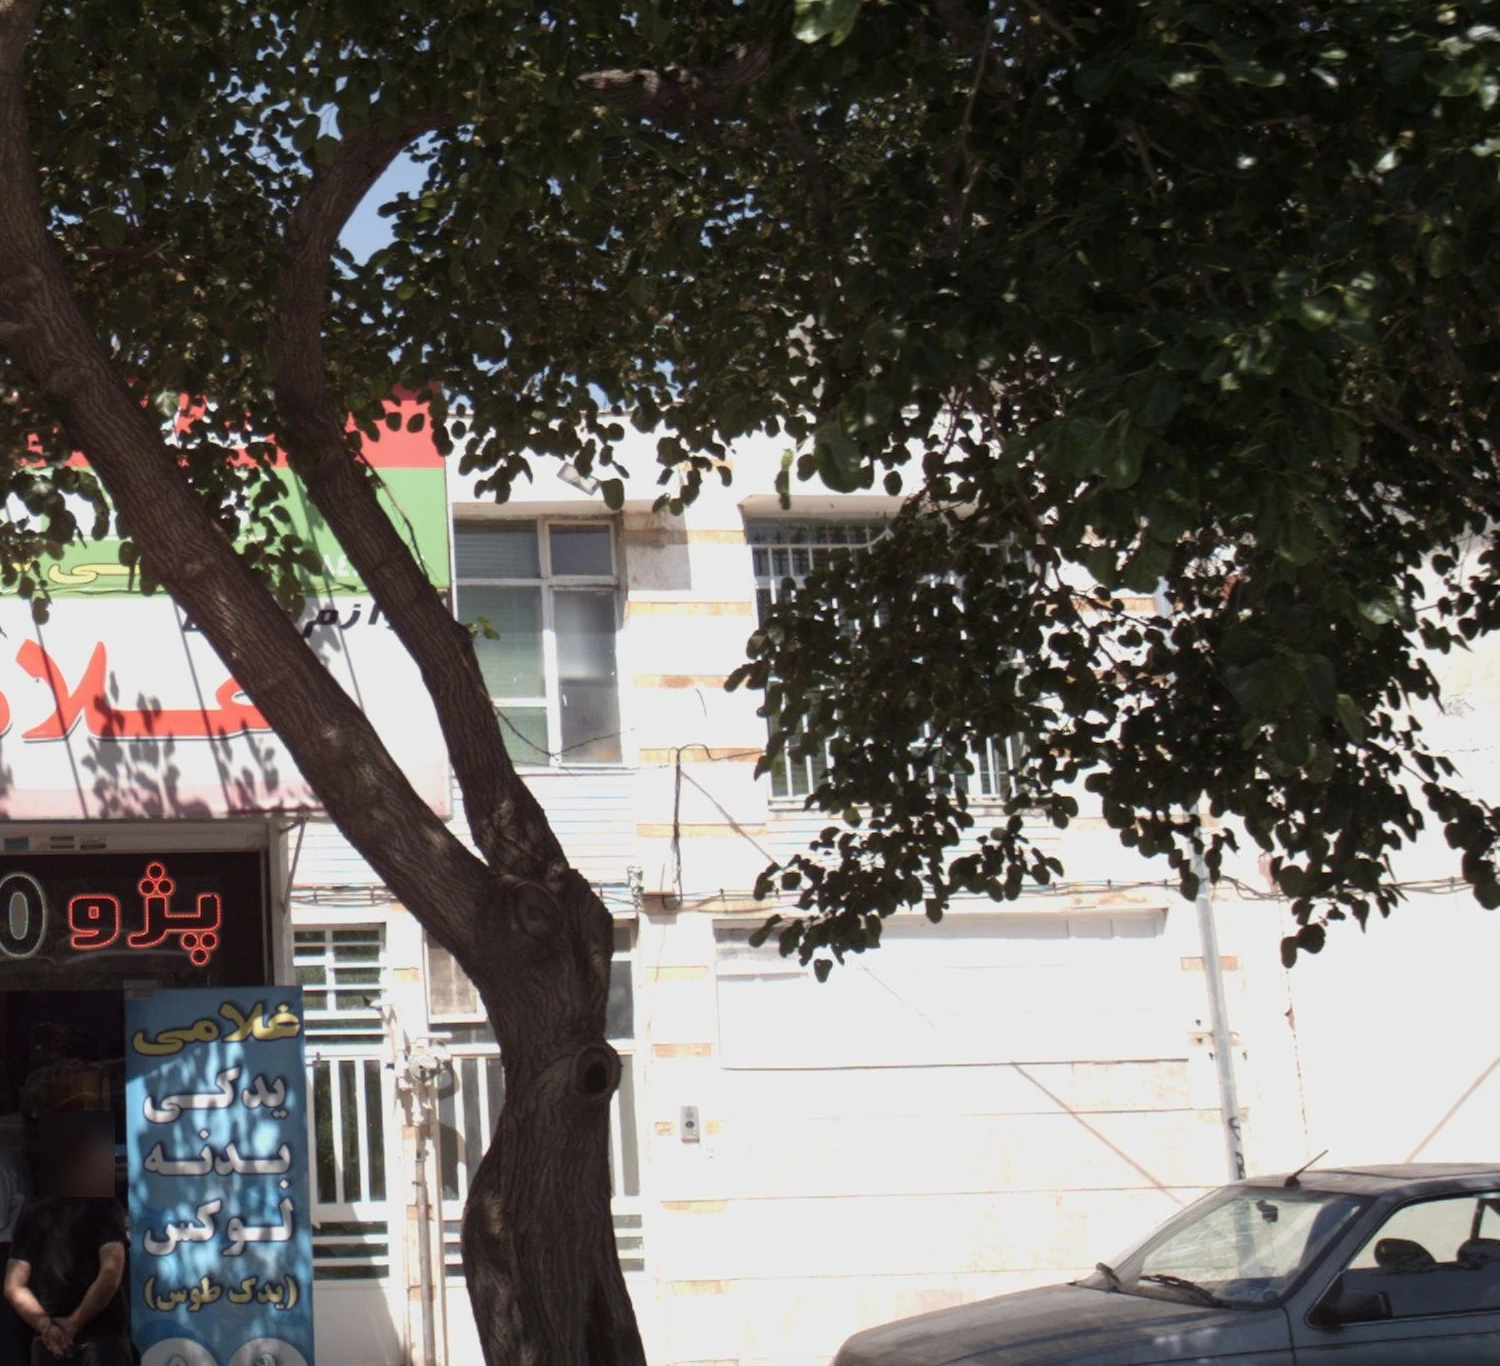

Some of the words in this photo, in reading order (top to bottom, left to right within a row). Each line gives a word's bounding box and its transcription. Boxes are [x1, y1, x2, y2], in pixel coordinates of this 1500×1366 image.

[66, 861, 223, 967] پژو
[132, 1000, 301, 1057] غلامی
[143, 1065, 288, 1125] یدکی
[144, 1128, 292, 1191] بدنه
[143, 1196, 295, 1257] لوکس
